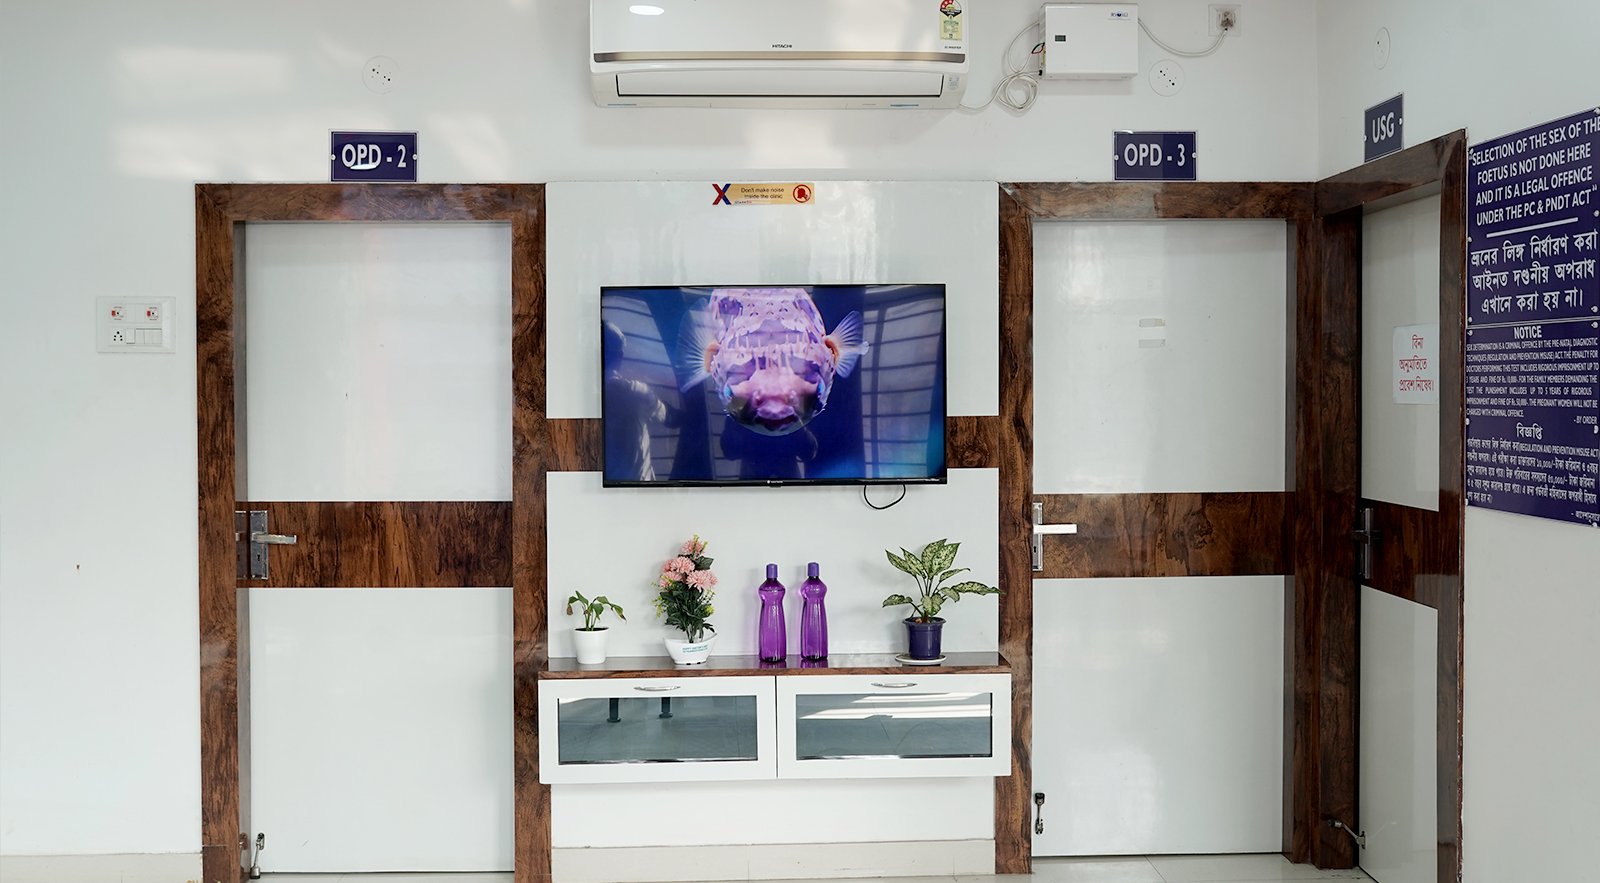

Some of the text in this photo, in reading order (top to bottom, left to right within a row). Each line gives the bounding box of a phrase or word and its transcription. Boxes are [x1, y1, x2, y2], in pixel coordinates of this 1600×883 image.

[1372, 112, 1395, 143] USG
[1516, 138, 1527, 154] OF
[1529, 132, 1547, 150] THE
[1548, 126, 1566, 144] SEX
[1568, 122, 1581, 139] OF
[342, 143, 382, 169] OPD
[397, 144, 406, 168] 2
[1124, 143, 1162, 166] OPD
[1177, 143, 1185, 166] 3
[1477, 142, 1591, 185] FOETUS IS NOT DONE HERE
[1476, 166, 1593, 206] AND IT IS A LEGAL OFFENCE
[1476, 208, 1504, 226] UNDER
[1506, 204, 1522, 220] THE
[1524, 201, 1536, 217] PC
[1537, 200, 1544, 214] &
[1545, 193, 1570, 212] PNDT
[1502, 240, 1526, 263] লিঙ্গ
[1530, 234, 1569, 259] নির্ধারণ
[1573, 228, 1598, 252] করা
[1472, 268, 1509, 292] আইনত
[1554, 258, 1596, 281] অপরাধ
[1481, 295, 1512, 315] এখানে
[1516, 291, 1539, 312] করা
[1543, 291, 1560, 311] হয়
[1514, 326, 1542, 339] NOTICE
[1522, 340, 1537, 349] OFFENCE
[1573, 338, 1598, 346] DIAGNOSTIC
[1558, 362, 1586, 371] IMPRISONMENT
[1586, 362, 1593, 371] UP
[1593, 362, 1599, 370] TO
[1530, 387, 1536, 395] UP
[1538, 387, 1543, 395] TO
[1549, 387, 1561, 395] YEARS
[1563, 387, 1569, 395] OF
[1571, 387, 1592, 395] RIGOROUS
[1589, 375, 1597, 383] THE
[1516, 422, 1543, 440] বিজ্ঞপ্তি
[1582, 416, 1598, 424] ORDER
